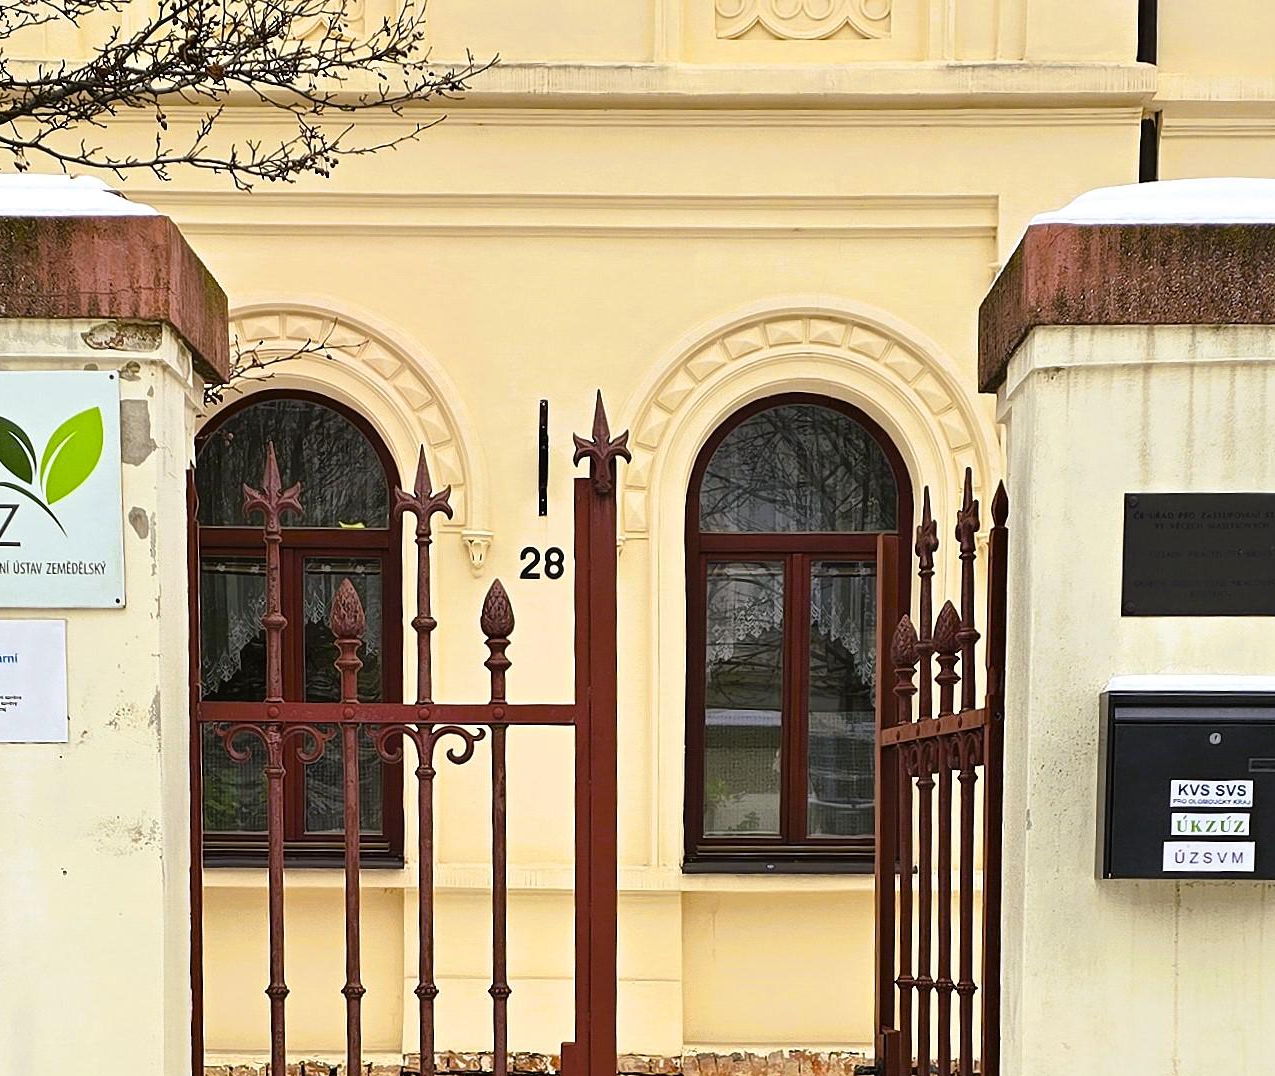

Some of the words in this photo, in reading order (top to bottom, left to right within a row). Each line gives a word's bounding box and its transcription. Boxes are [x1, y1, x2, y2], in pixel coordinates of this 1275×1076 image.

[13, 560, 43, 575] ÚSTAV
[46, 560, 107, 575] ZEMĚDĚLSKÝ
[520, 546, 565, 580] 28
[1178, 784, 1210, 796] KVS
[1215, 784, 1247, 797] SVS
[1176, 815, 1245, 833] ÚKZÚZ
